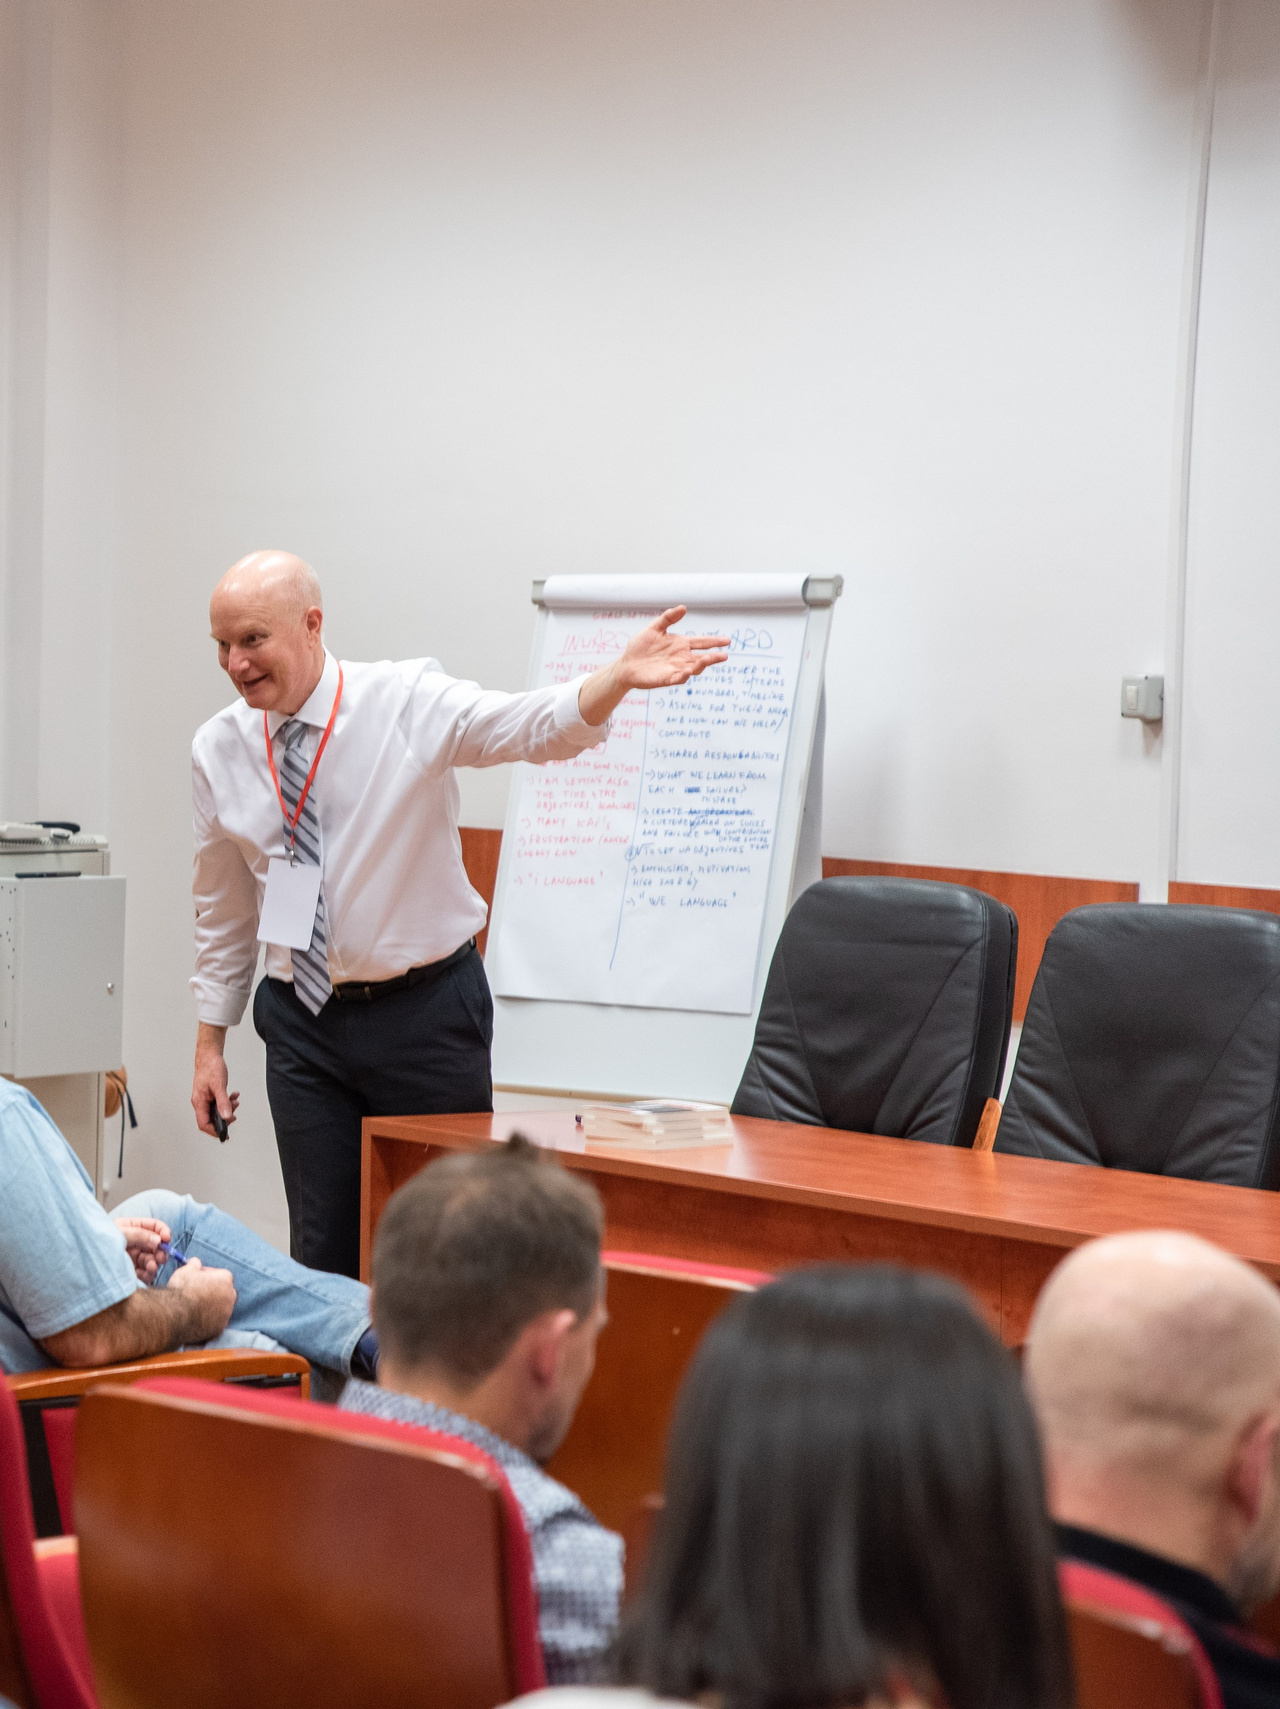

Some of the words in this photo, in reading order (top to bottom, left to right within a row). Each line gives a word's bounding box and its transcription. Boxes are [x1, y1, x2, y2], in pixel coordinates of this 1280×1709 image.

[711, 665, 758, 675] TOGETHER
[762, 667, 781, 675] THE
[686, 675, 734, 685] JECTIVES
[669, 699, 703, 710] ASKING
[709, 704, 726, 713] FOR
[666, 716, 685, 724] AND
[688, 716, 708, 724] HOW
[661, 749, 699, 759] SHARED
[657, 770, 686, 780] WHAT
[690, 771, 704, 779] WE
[706, 771, 737, 780] LEARN
[739, 771, 767, 780] FROM
[648, 785, 674, 794] EACH
[537, 816, 567, 827] MANY
[632, 877, 653, 887] HIGH
